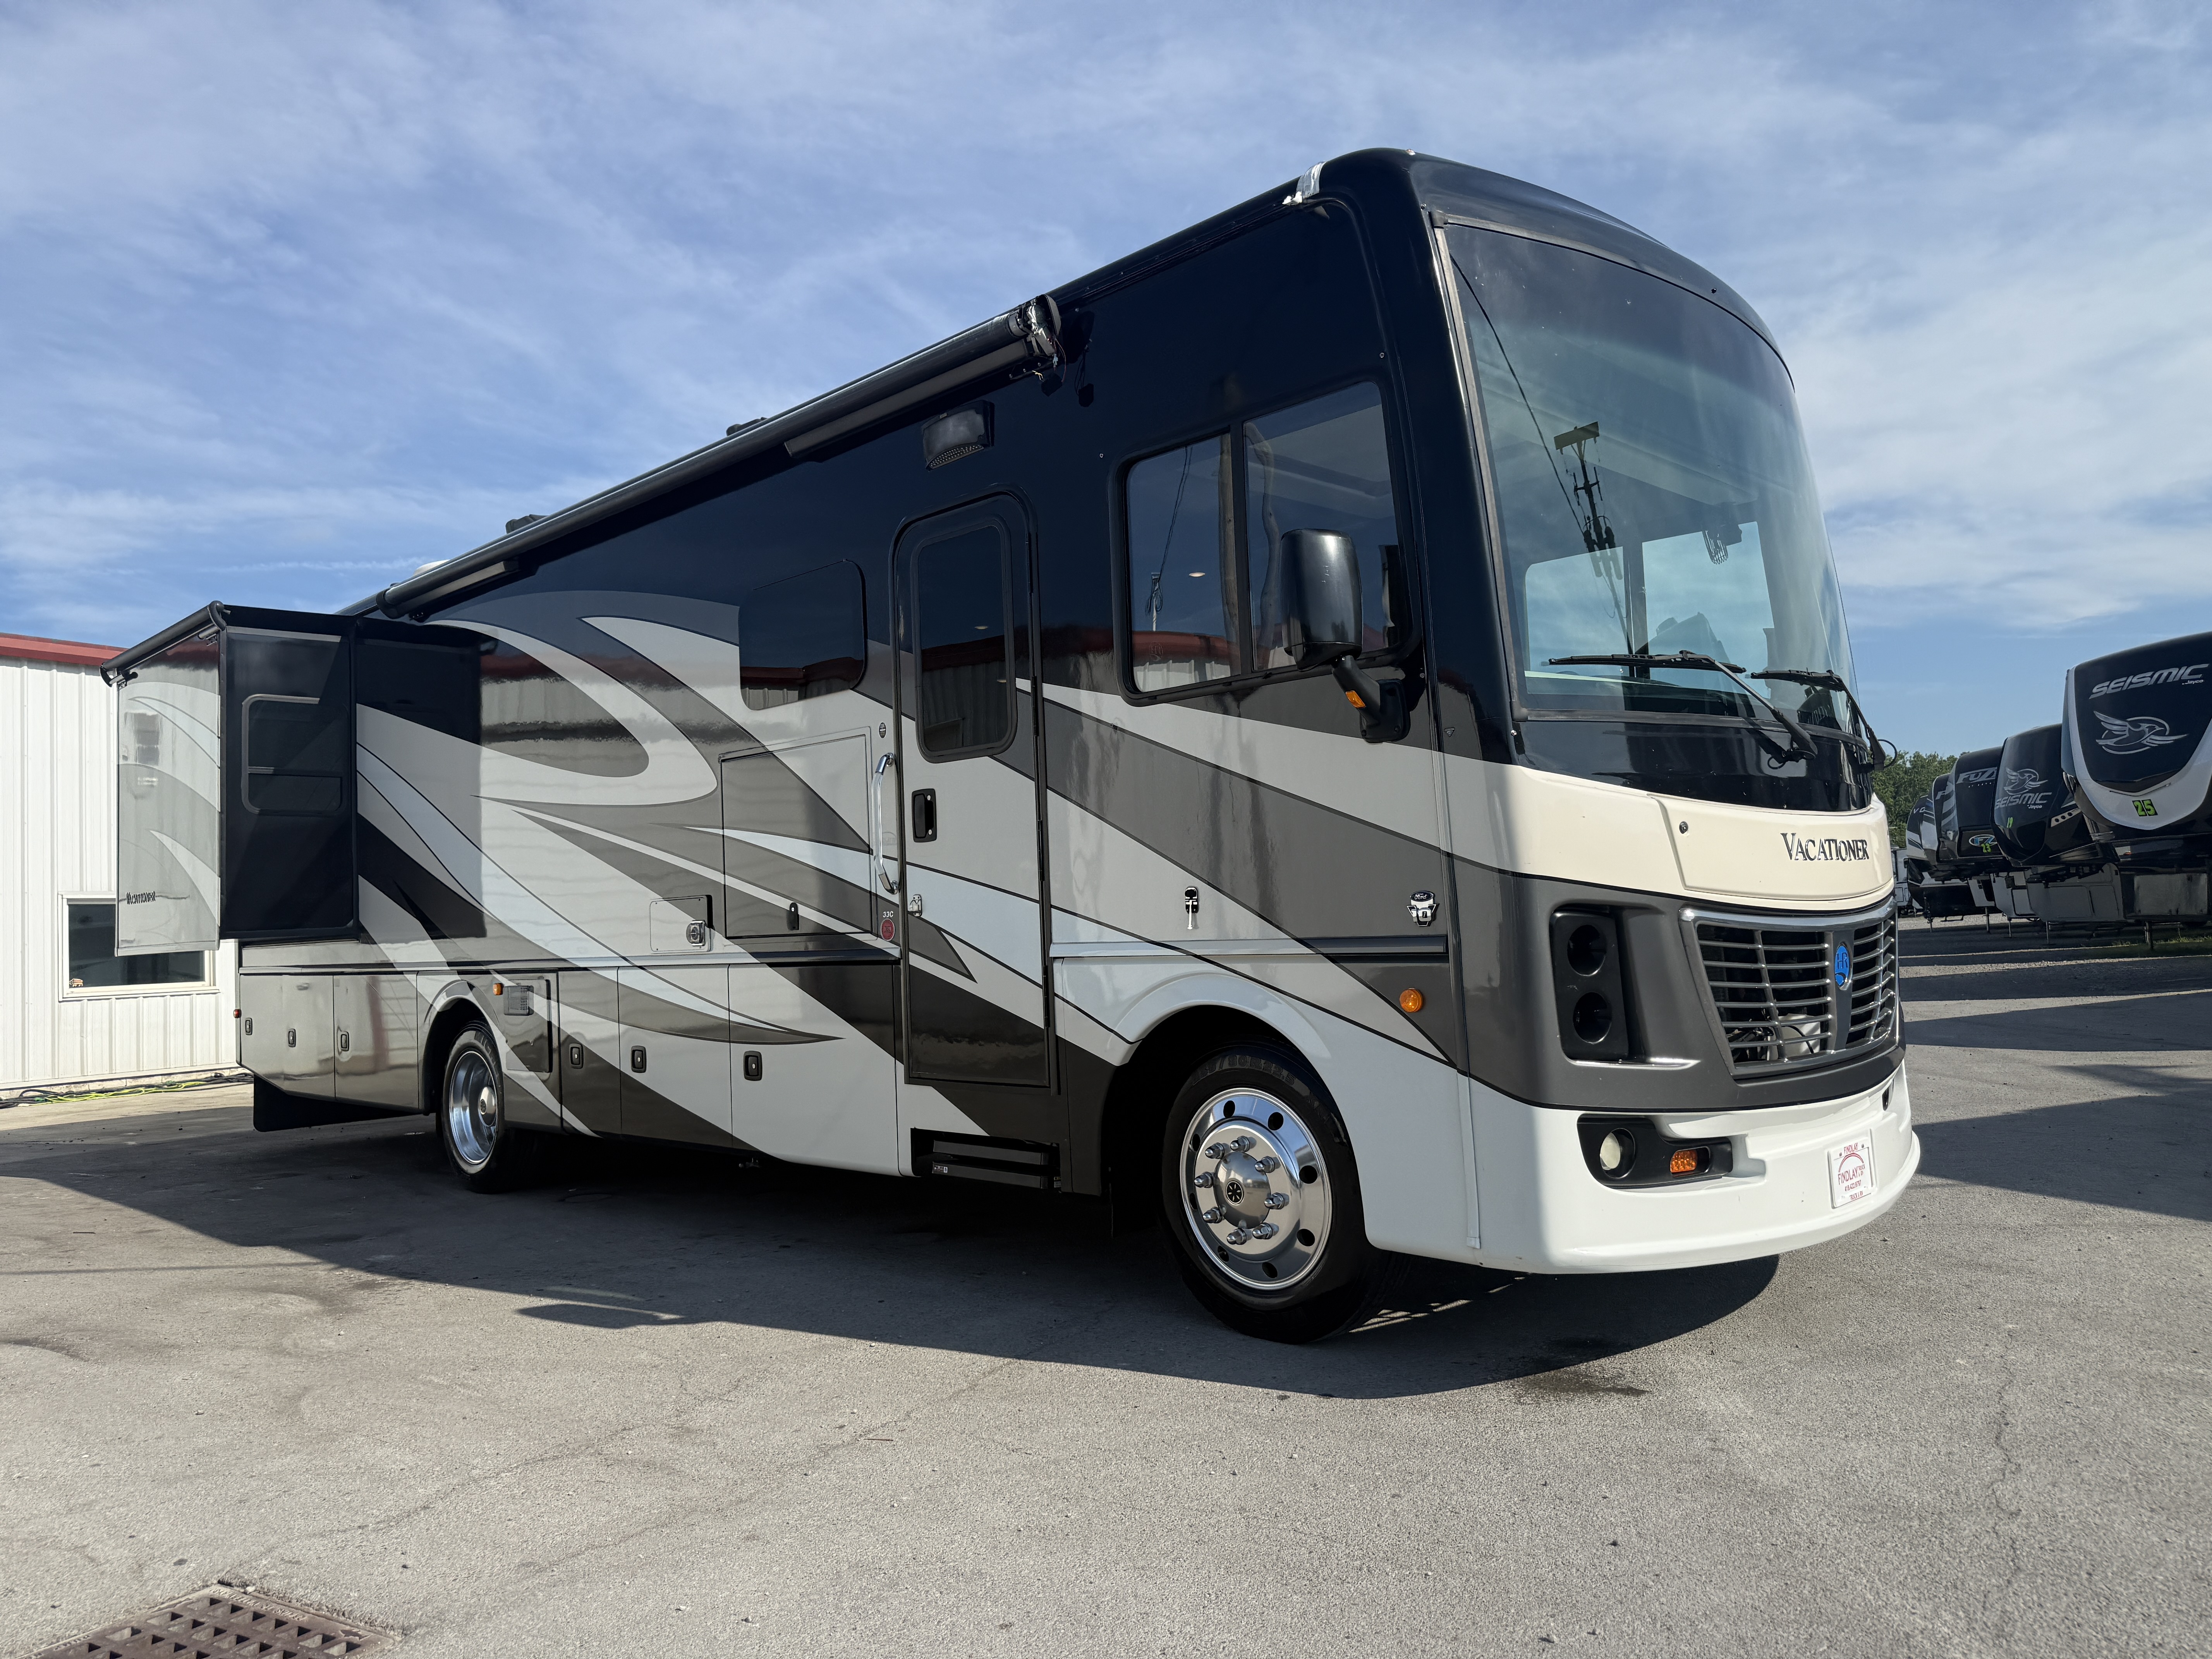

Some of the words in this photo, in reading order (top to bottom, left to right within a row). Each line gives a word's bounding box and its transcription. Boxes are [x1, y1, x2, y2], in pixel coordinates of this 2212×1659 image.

[2089, 663, 2209, 699] SEISMIC
[1995, 792, 2052, 809] SEISMIC
[2133, 800, 2155, 815] 25
[2007, 817, 2013, 828] 19
[1780, 833, 1869, 861] VACATIONER
[1981, 843, 1992, 853] 23
[1837, 953, 1848, 969] HR
[1844, 1143, 1858, 1155] FINDLAY
[1838, 1167, 1858, 1185] FINDLAY
